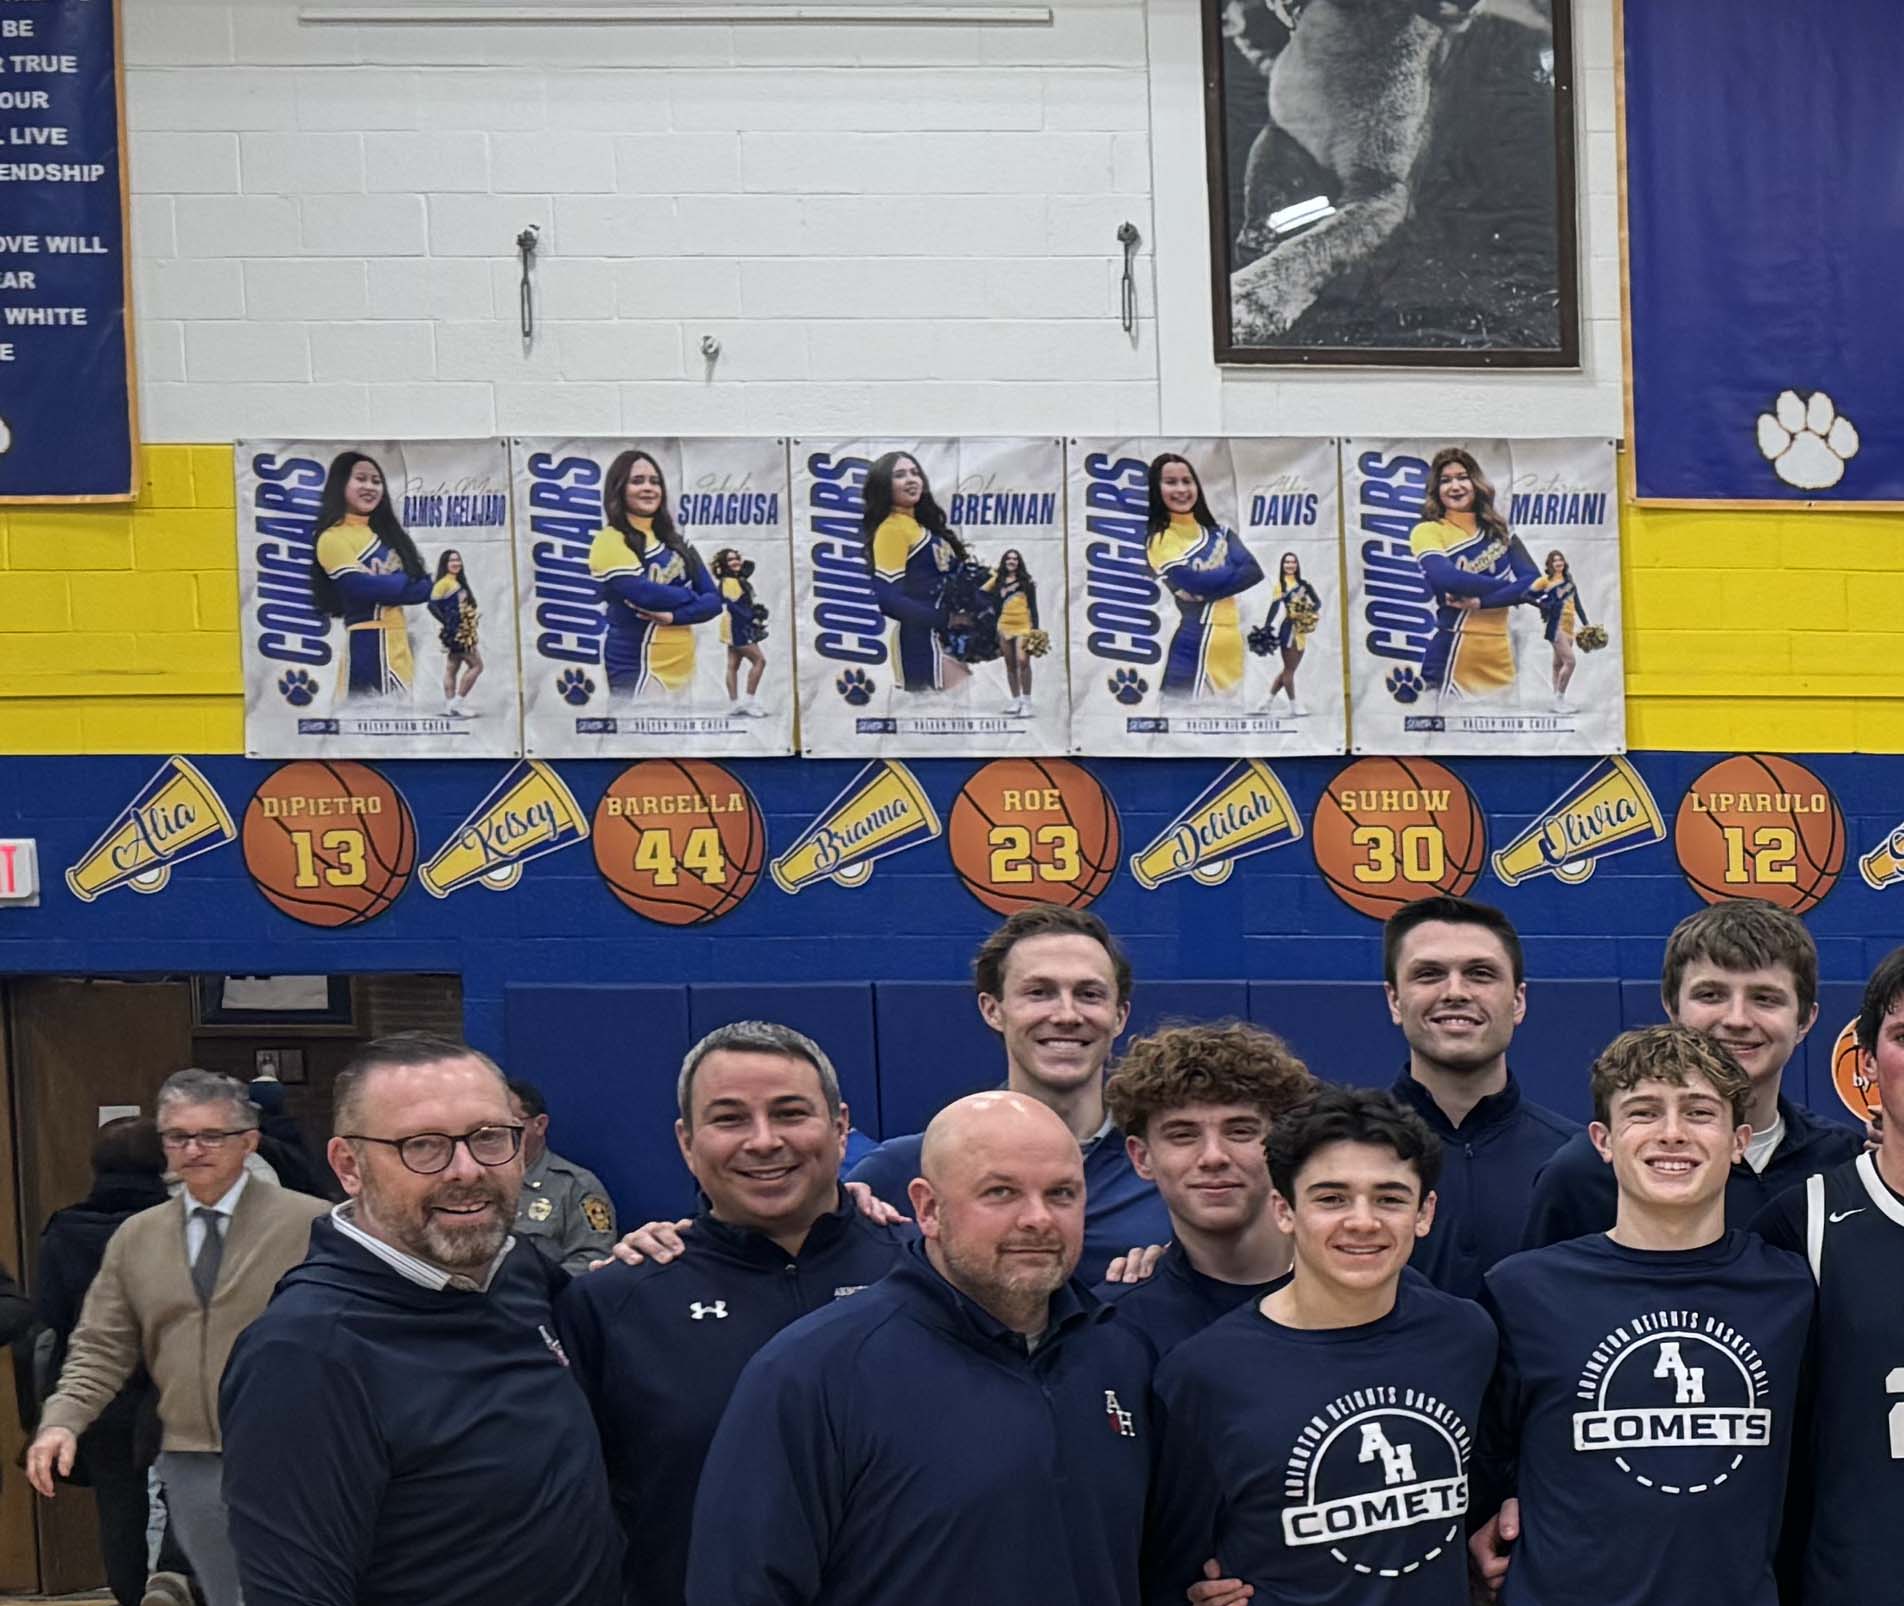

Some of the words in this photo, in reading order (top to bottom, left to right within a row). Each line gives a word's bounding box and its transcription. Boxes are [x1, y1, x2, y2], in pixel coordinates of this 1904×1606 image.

[2, 20, 33, 37] BE
[10, 56, 78, 74] TRUE
[10, 128, 68, 145] LIVE
[46, 236, 108, 253] WILL
[5, 308, 87, 326] WHITE
[677, 493, 779, 525] SIRAGUSA
[949, 492, 1056, 527] BRENNAN
[1248, 493, 1318, 528] DAVIS
[1509, 492, 1608, 527] MARIANI
[253, 452, 333, 667] COUGARS
[528, 451, 602, 665] COUGARS
[807, 451, 888, 665] COUGARS
[1084, 451, 1166, 665] COUGARS
[1358, 450, 1434, 663] COUGARS
[460, 796, 561, 861] Kelsey
[607, 793, 744, 817] BARGELLA
[1002, 789, 1061, 812] ROE
[1173, 791, 1272, 867] Delilah
[1340, 789, 1451, 812] SUHOW
[1691, 792, 1827, 815] LIPARULO
[112, 800, 197, 872] Alia
[291, 829, 368, 888] 13
[633, 829, 727, 887] 44
[815, 798, 909, 870] Brianna
[988, 825, 1082, 883] 23
[1352, 825, 1446, 883] 30
[1539, 798, 1637, 863] Olivia
[1722, 826, 1799, 884] 12
[1582, 1414, 1766, 1443] COMETS
[1291, 1482, 1467, 1538] COMETS
